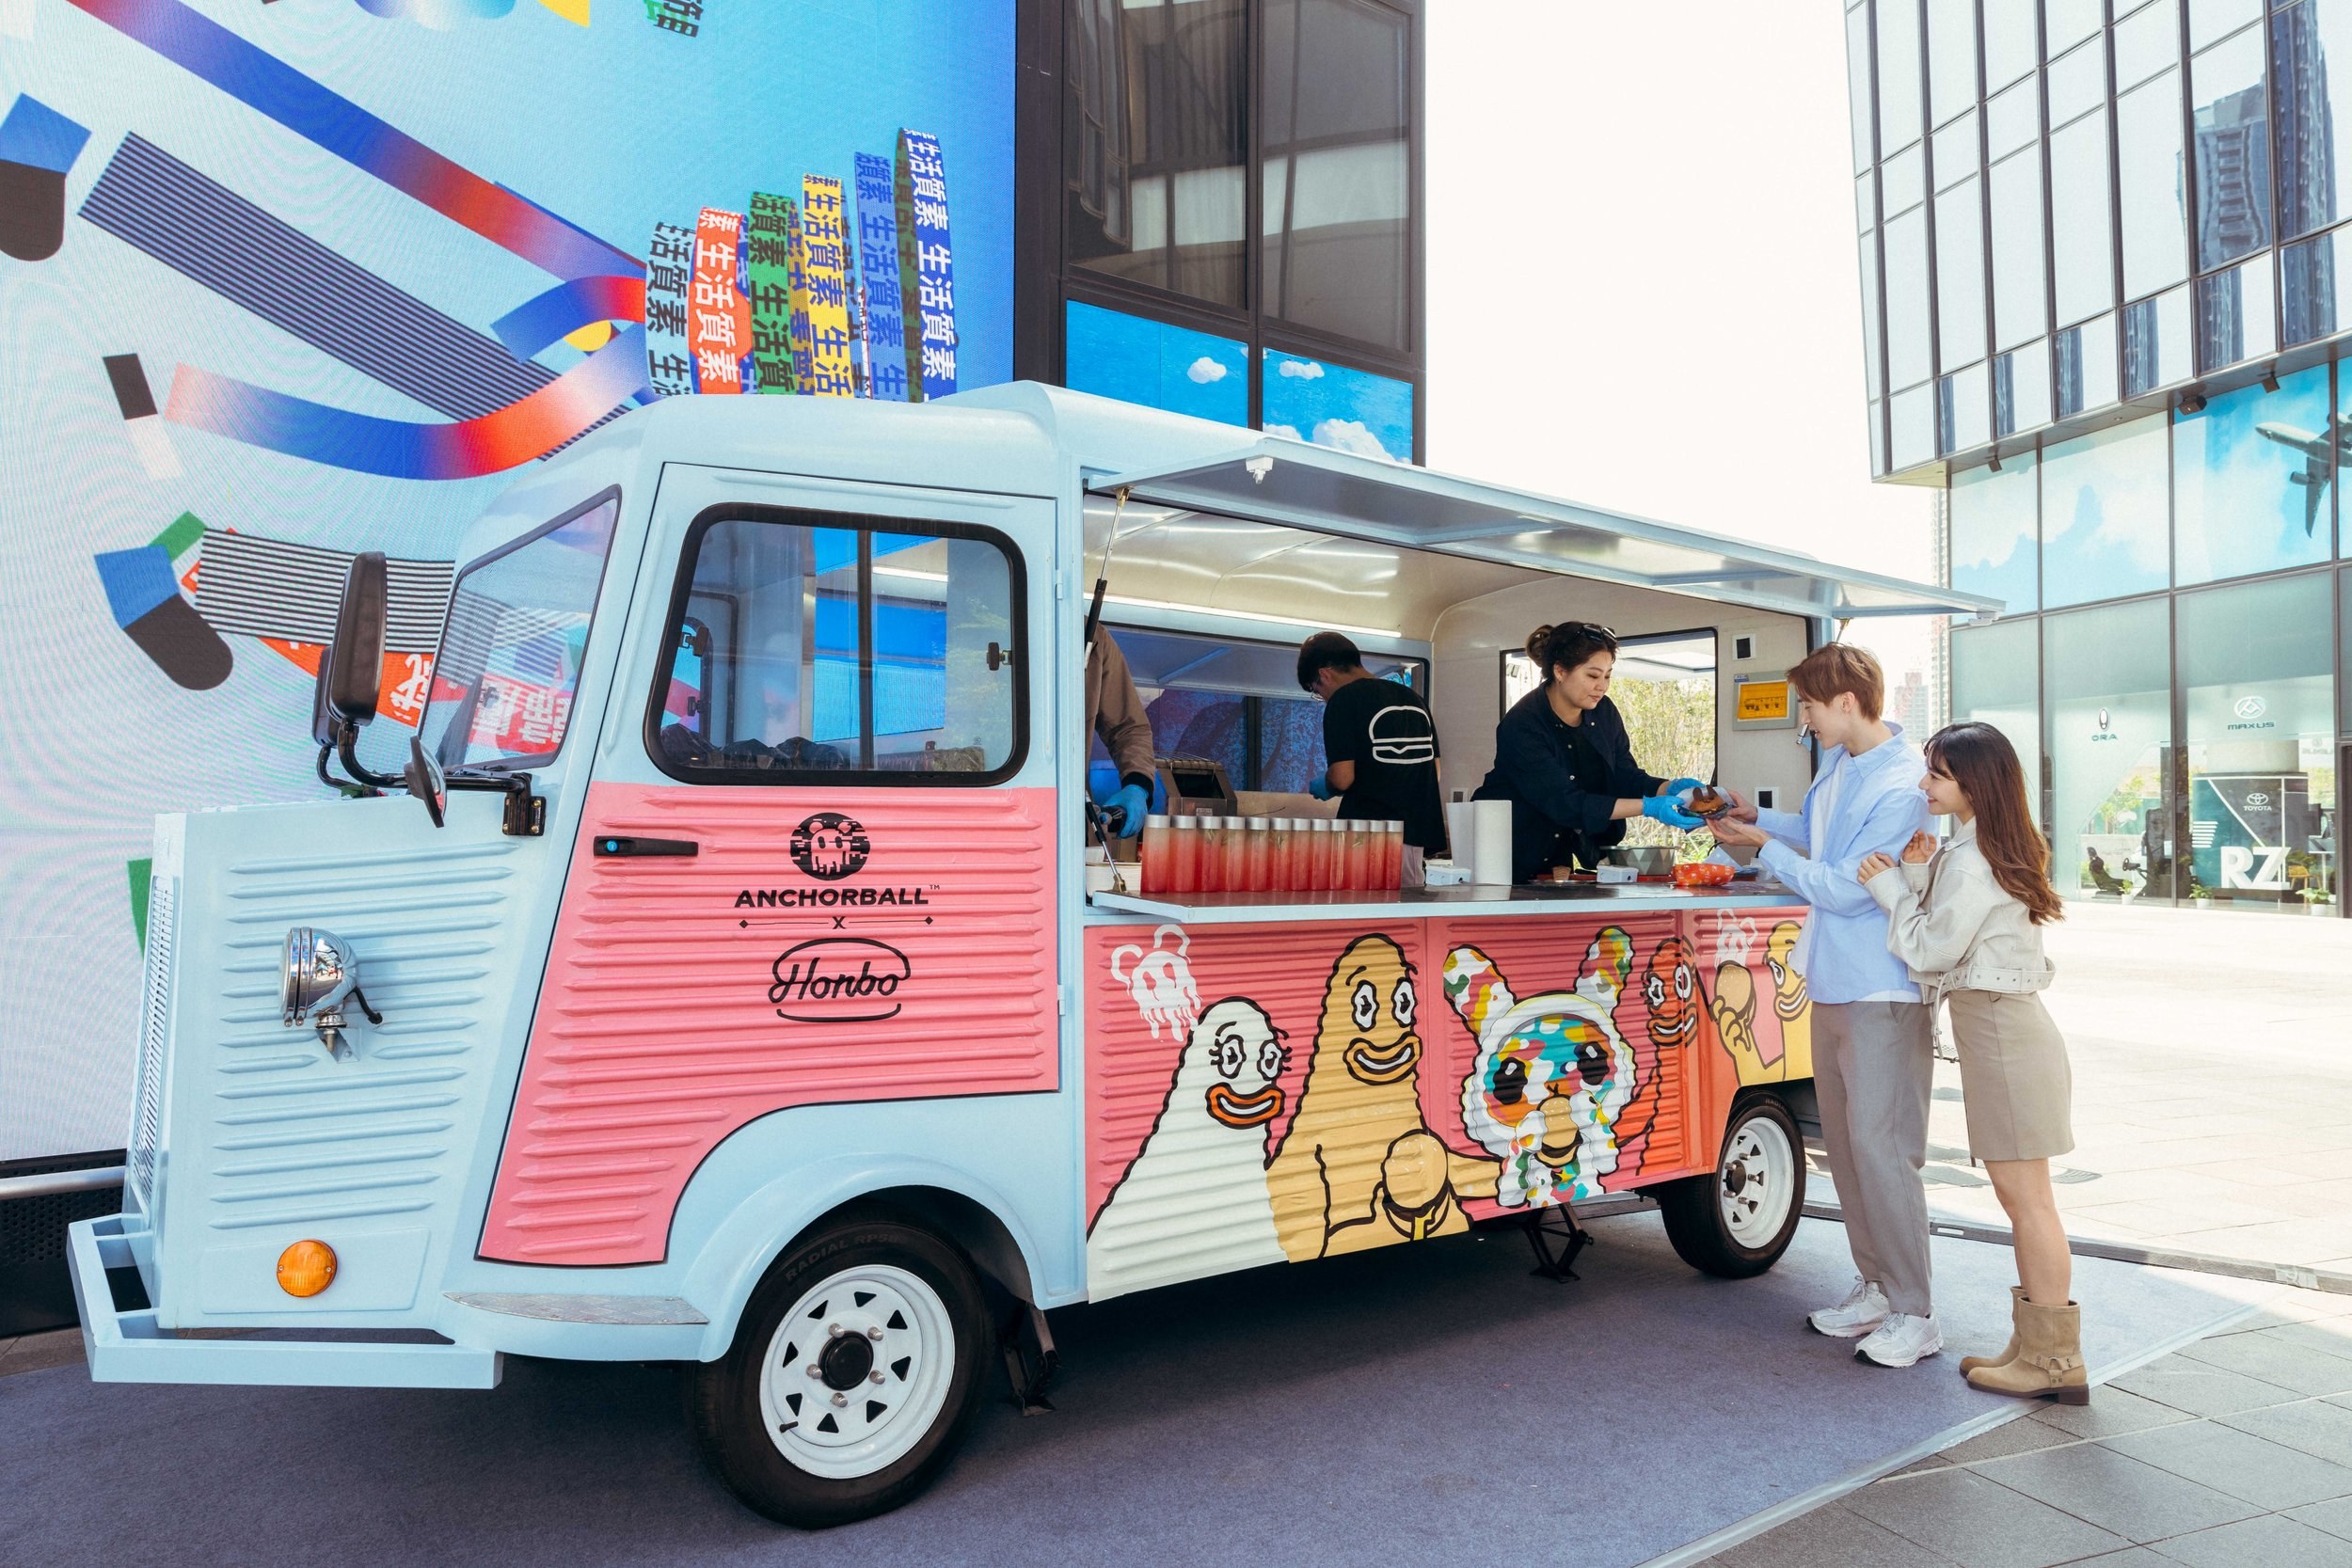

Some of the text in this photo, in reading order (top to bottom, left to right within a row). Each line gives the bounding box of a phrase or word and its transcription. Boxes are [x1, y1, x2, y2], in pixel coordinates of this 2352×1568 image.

[906, 138, 948, 231] 生活質素
[803, 190, 845, 309] 生活質素
[862, 211, 902, 348] 生活質素
[694, 238, 739, 383] 生活質素
[750, 193, 794, 393] 活質素 生活質
[917, 240, 956, 381] 生活質素
[811, 324, 852, 397] 生活
[871, 362, 907, 399] 生
[2227, 721, 2275, 731] MAXUS
[734, 887, 929, 908] ANCHORBALL
[2220, 846, 2291, 890] RZ
[768, 957, 900, 1004] Honbo
[785, 1240, 850, 1283] RADIAL
